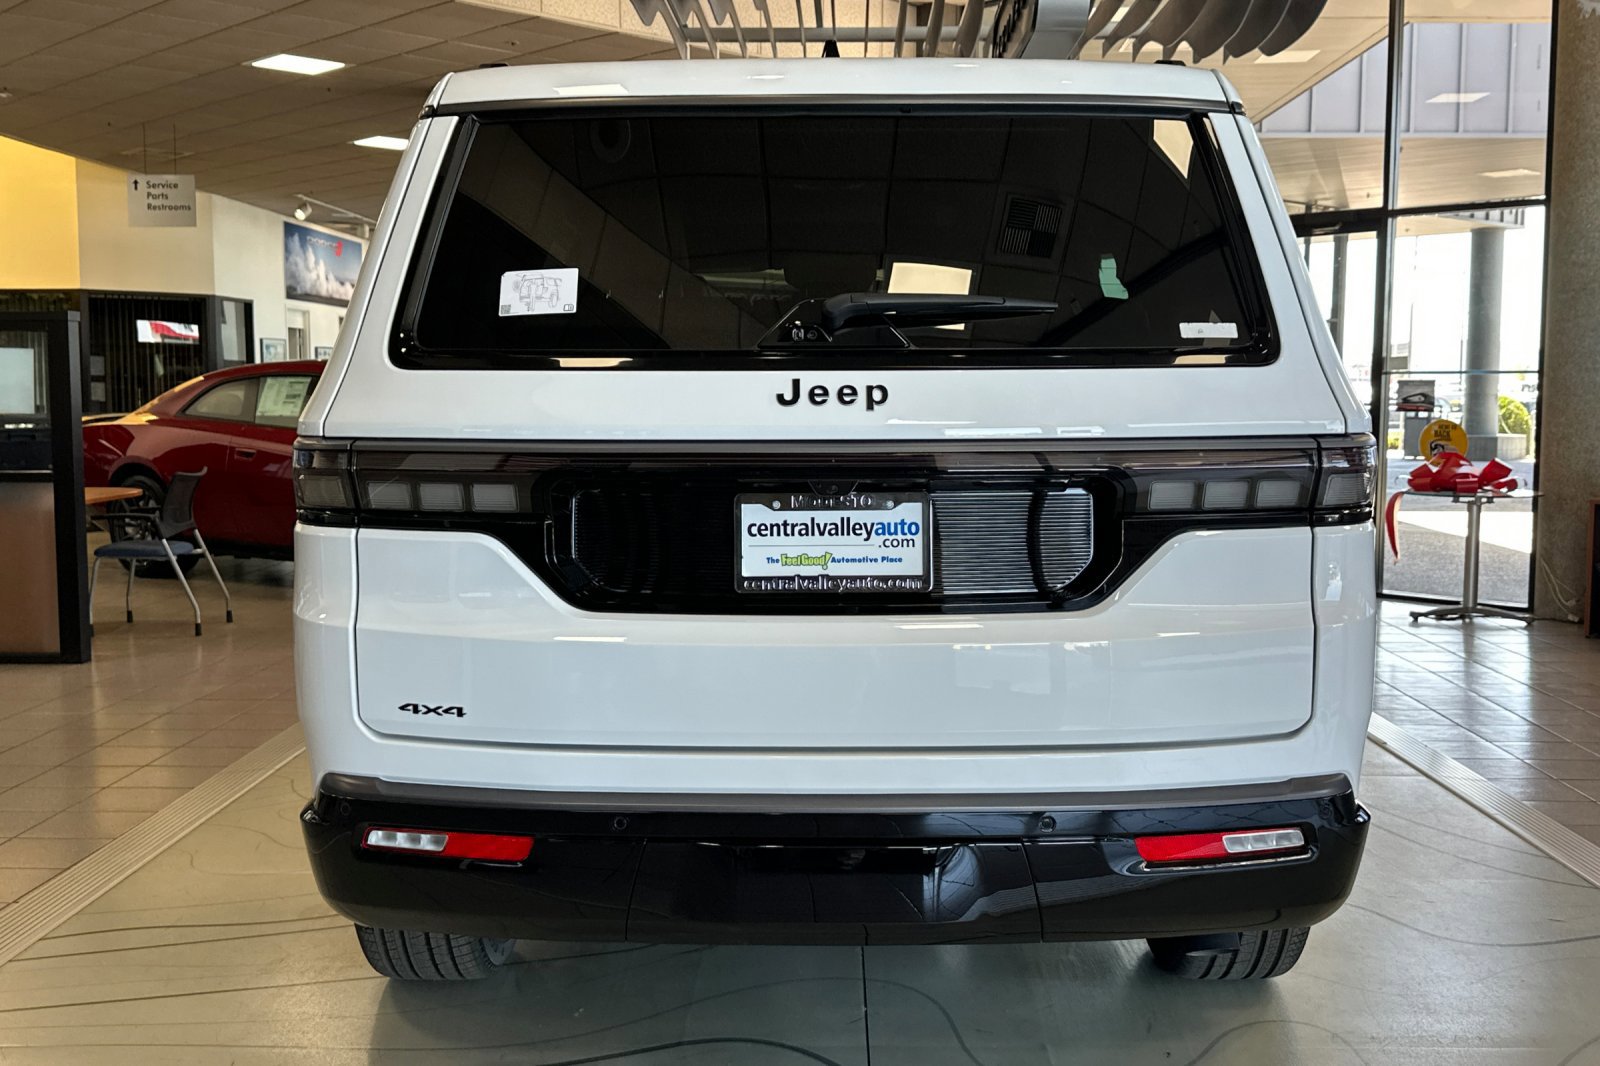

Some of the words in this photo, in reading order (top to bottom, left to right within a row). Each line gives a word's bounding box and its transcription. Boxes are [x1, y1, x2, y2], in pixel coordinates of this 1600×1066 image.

[146, 180, 179, 189] Service
[146, 191, 169, 200] Parts
[147, 203, 191, 211] Restrooms
[776, 378, 889, 412] Jeep
[747, 517, 920, 541] centralvalleyauto
[878, 537, 915, 548] .com
[766, 556, 780, 564] The
[831, 556, 878, 564] Automotive
